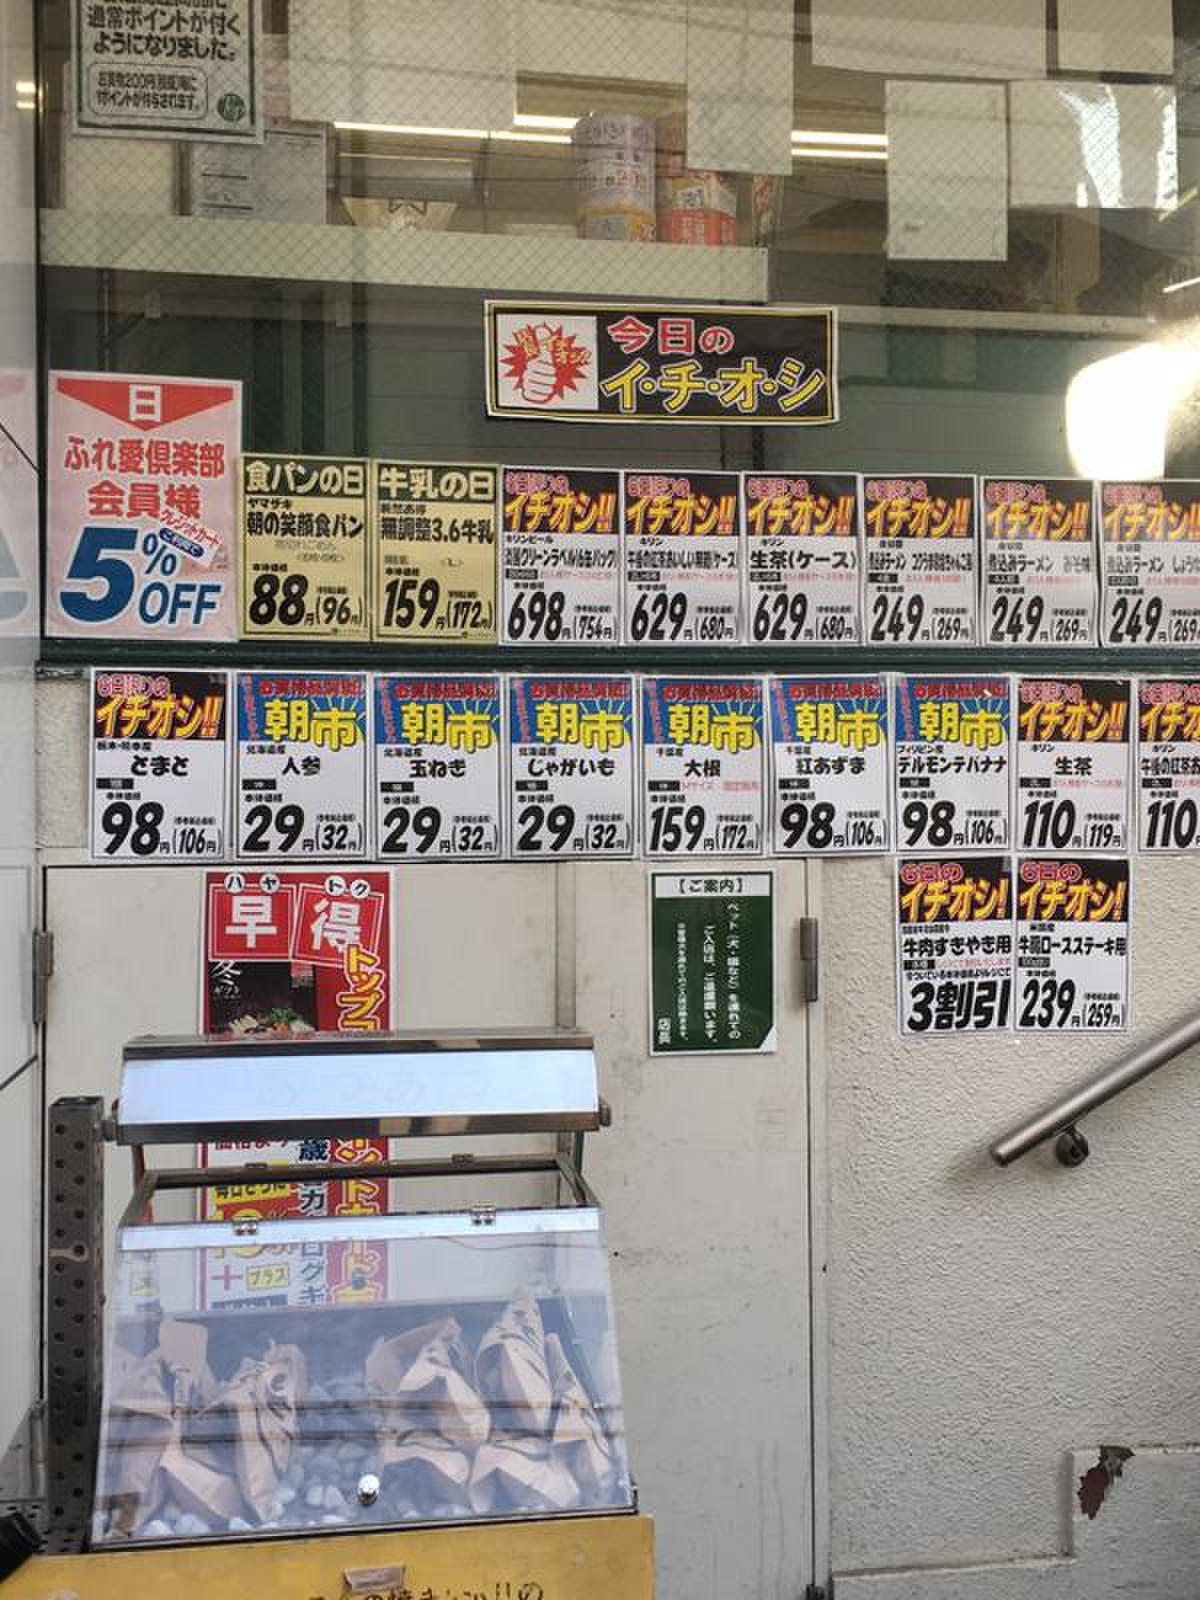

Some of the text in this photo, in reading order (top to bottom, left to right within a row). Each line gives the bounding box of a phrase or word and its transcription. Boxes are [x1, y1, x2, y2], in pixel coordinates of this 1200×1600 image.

[88, 5, 241, 36] 通常ポイントが付く
[94, 32, 236, 61] ようになりました。
[606, 317, 735, 354] 今日の
[129, 384, 160, 421] 日
[64, 435, 225, 480] ふれ愛倶楽部
[245, 460, 364, 495] 食パンの日
[379, 465, 495, 500] 牛乳の日
[88, 479, 201, 520] 会員様
[248, 511, 364, 538] 朝の笑顔食パン
[382, 516, 494, 544] 無調整3.6牛乳
[750, 549, 857, 570] 生茶(ケース)
[138, 582, 222, 625] OFF
[96, 694, 225, 739] イチオシ!!
[263, 698, 360, 752] 朝市
[400, 702, 493, 755] 朝市
[535, 702, 627, 755] 朝市
[667, 702, 756, 754] 朝市
[794, 702, 881, 753] 朝市
[918, 700, 1005, 752] 朝市
[131, 755, 189, 776] とまと
[281, 756, 321, 776] 人参
[409, 758, 467, 778] 玉ねぎ
[527, 758, 616, 777] じゃがいも
[684, 759, 721, 777] 大根
[796, 757, 866, 776] 紅あずま
[1054, 757, 1093, 776] 生茶
[679, 877, 744, 894] 【ご案内】
[907, 980, 1011, 1032] 3割引
